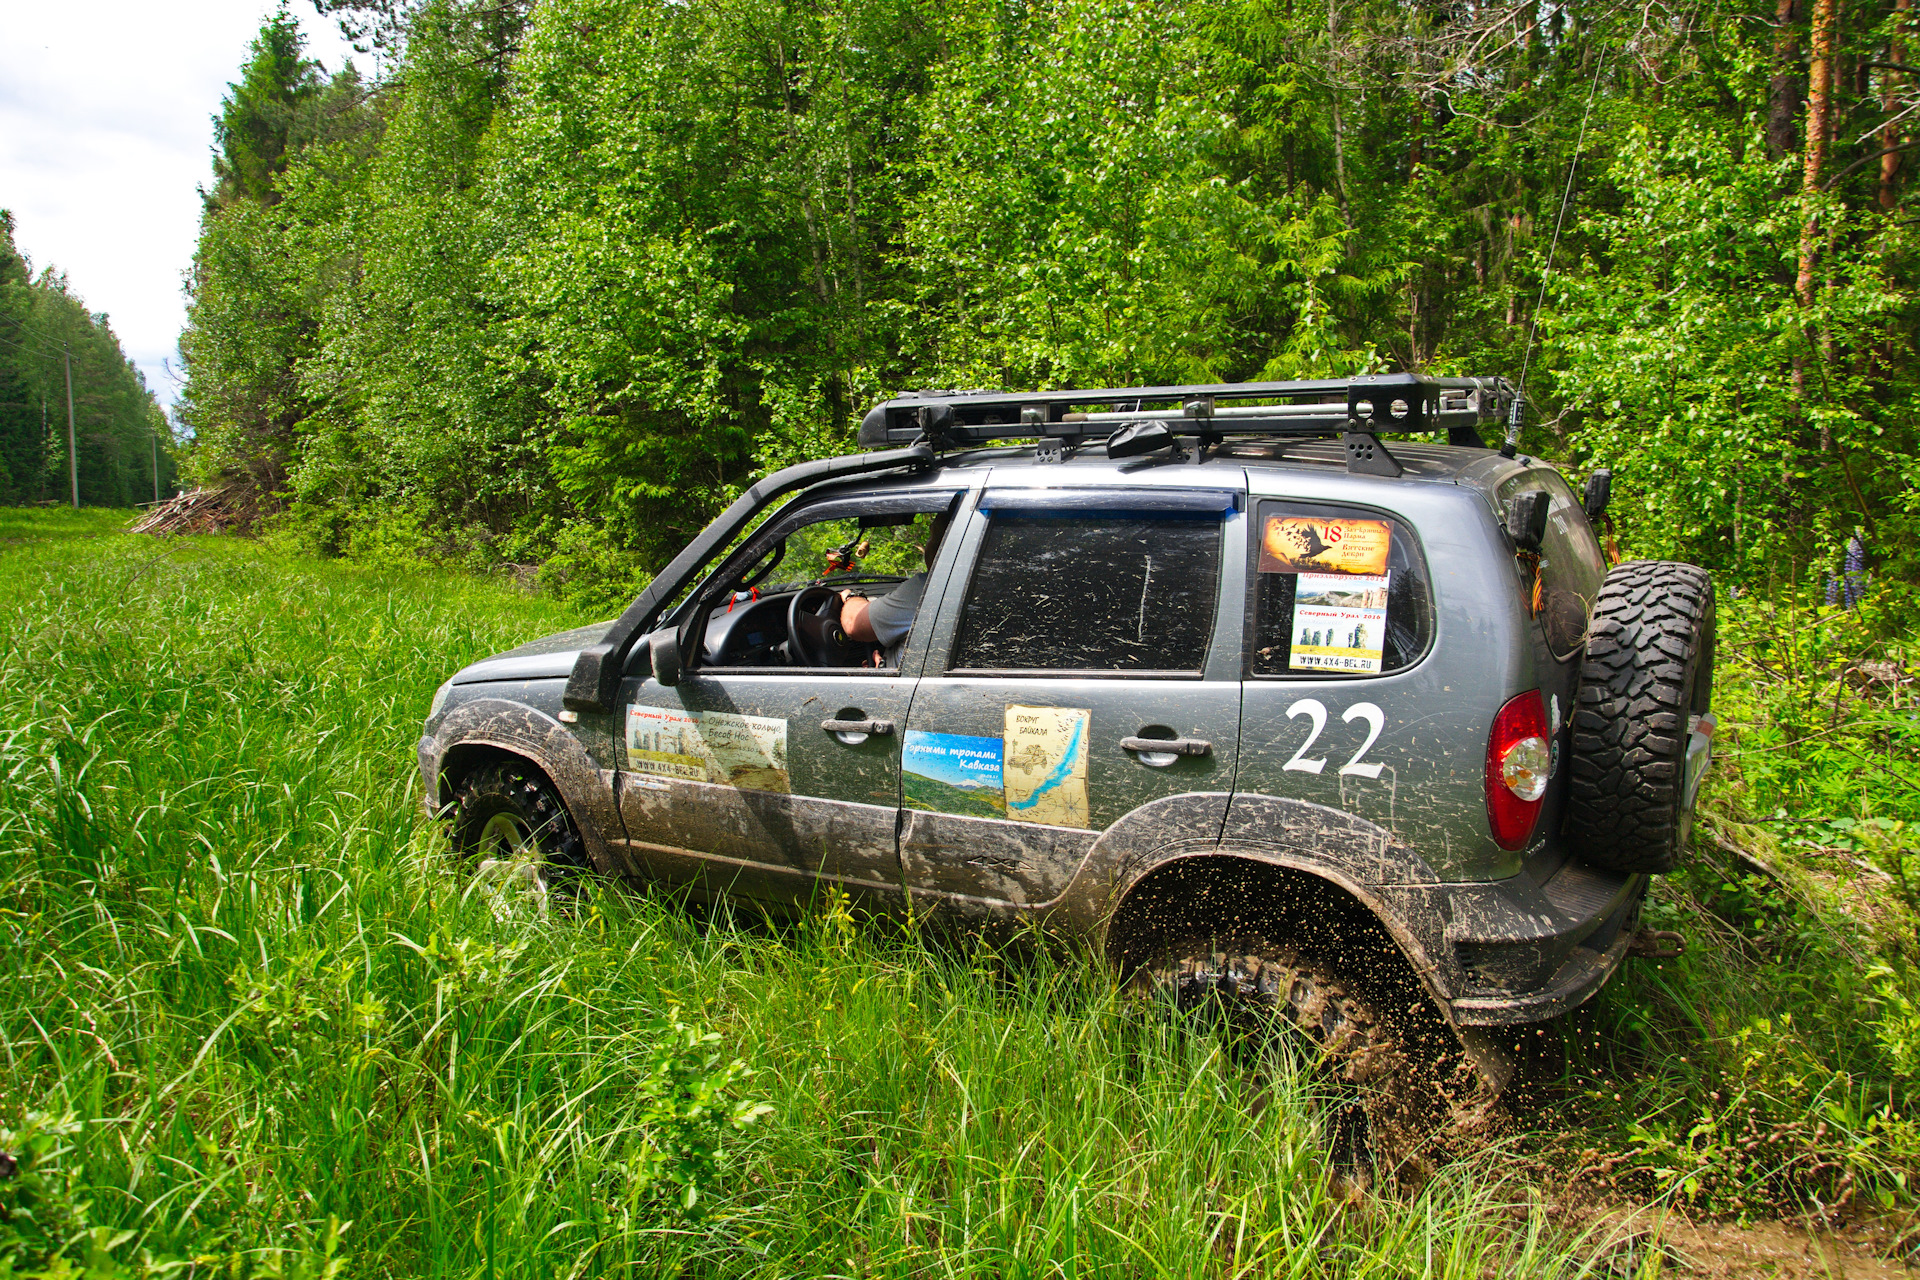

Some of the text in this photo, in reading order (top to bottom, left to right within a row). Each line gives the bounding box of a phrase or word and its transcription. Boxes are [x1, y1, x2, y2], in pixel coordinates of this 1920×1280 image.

[1299, 609, 1338, 618] Северный
[1340, 611, 1360, 619] Урал
[629, 709, 662, 720] Северный
[664, 713, 683, 722] Урал
[708, 716, 750, 729] Онежское
[708, 727, 750, 741] Бесов Нос
[1281, 698, 1385, 779] 22
[903, 742, 997, 760] Горными тропами
[959, 759, 1000, 772] Кавказа
